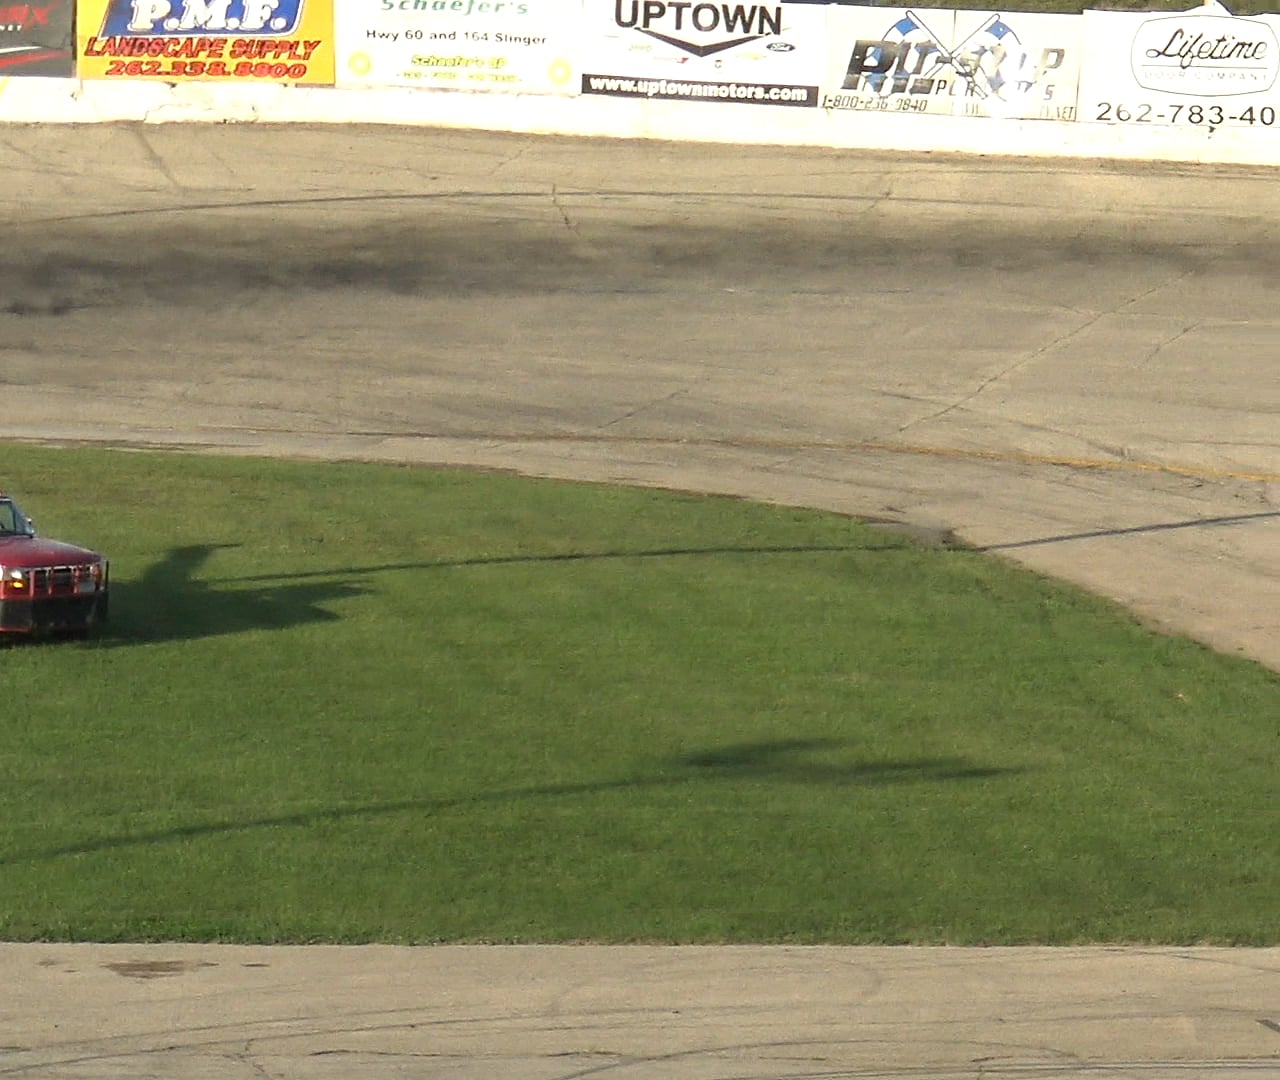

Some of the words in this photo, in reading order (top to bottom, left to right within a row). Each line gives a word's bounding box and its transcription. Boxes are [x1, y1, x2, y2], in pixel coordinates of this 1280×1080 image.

[614, 0, 782, 36] UPTOWN
[84, 37, 227, 59] LANDSCAPE
[230, 40, 322, 61] SUPPLY
[366, 29, 399, 42] Hwy
[405, 30, 423, 40] 60
[429, 31, 456, 41] and
[495, 33, 547, 46] Slinger
[1145, 28, 1268, 69] Lifetime
[590, 76, 808, 101] www.uptownmotors.com
